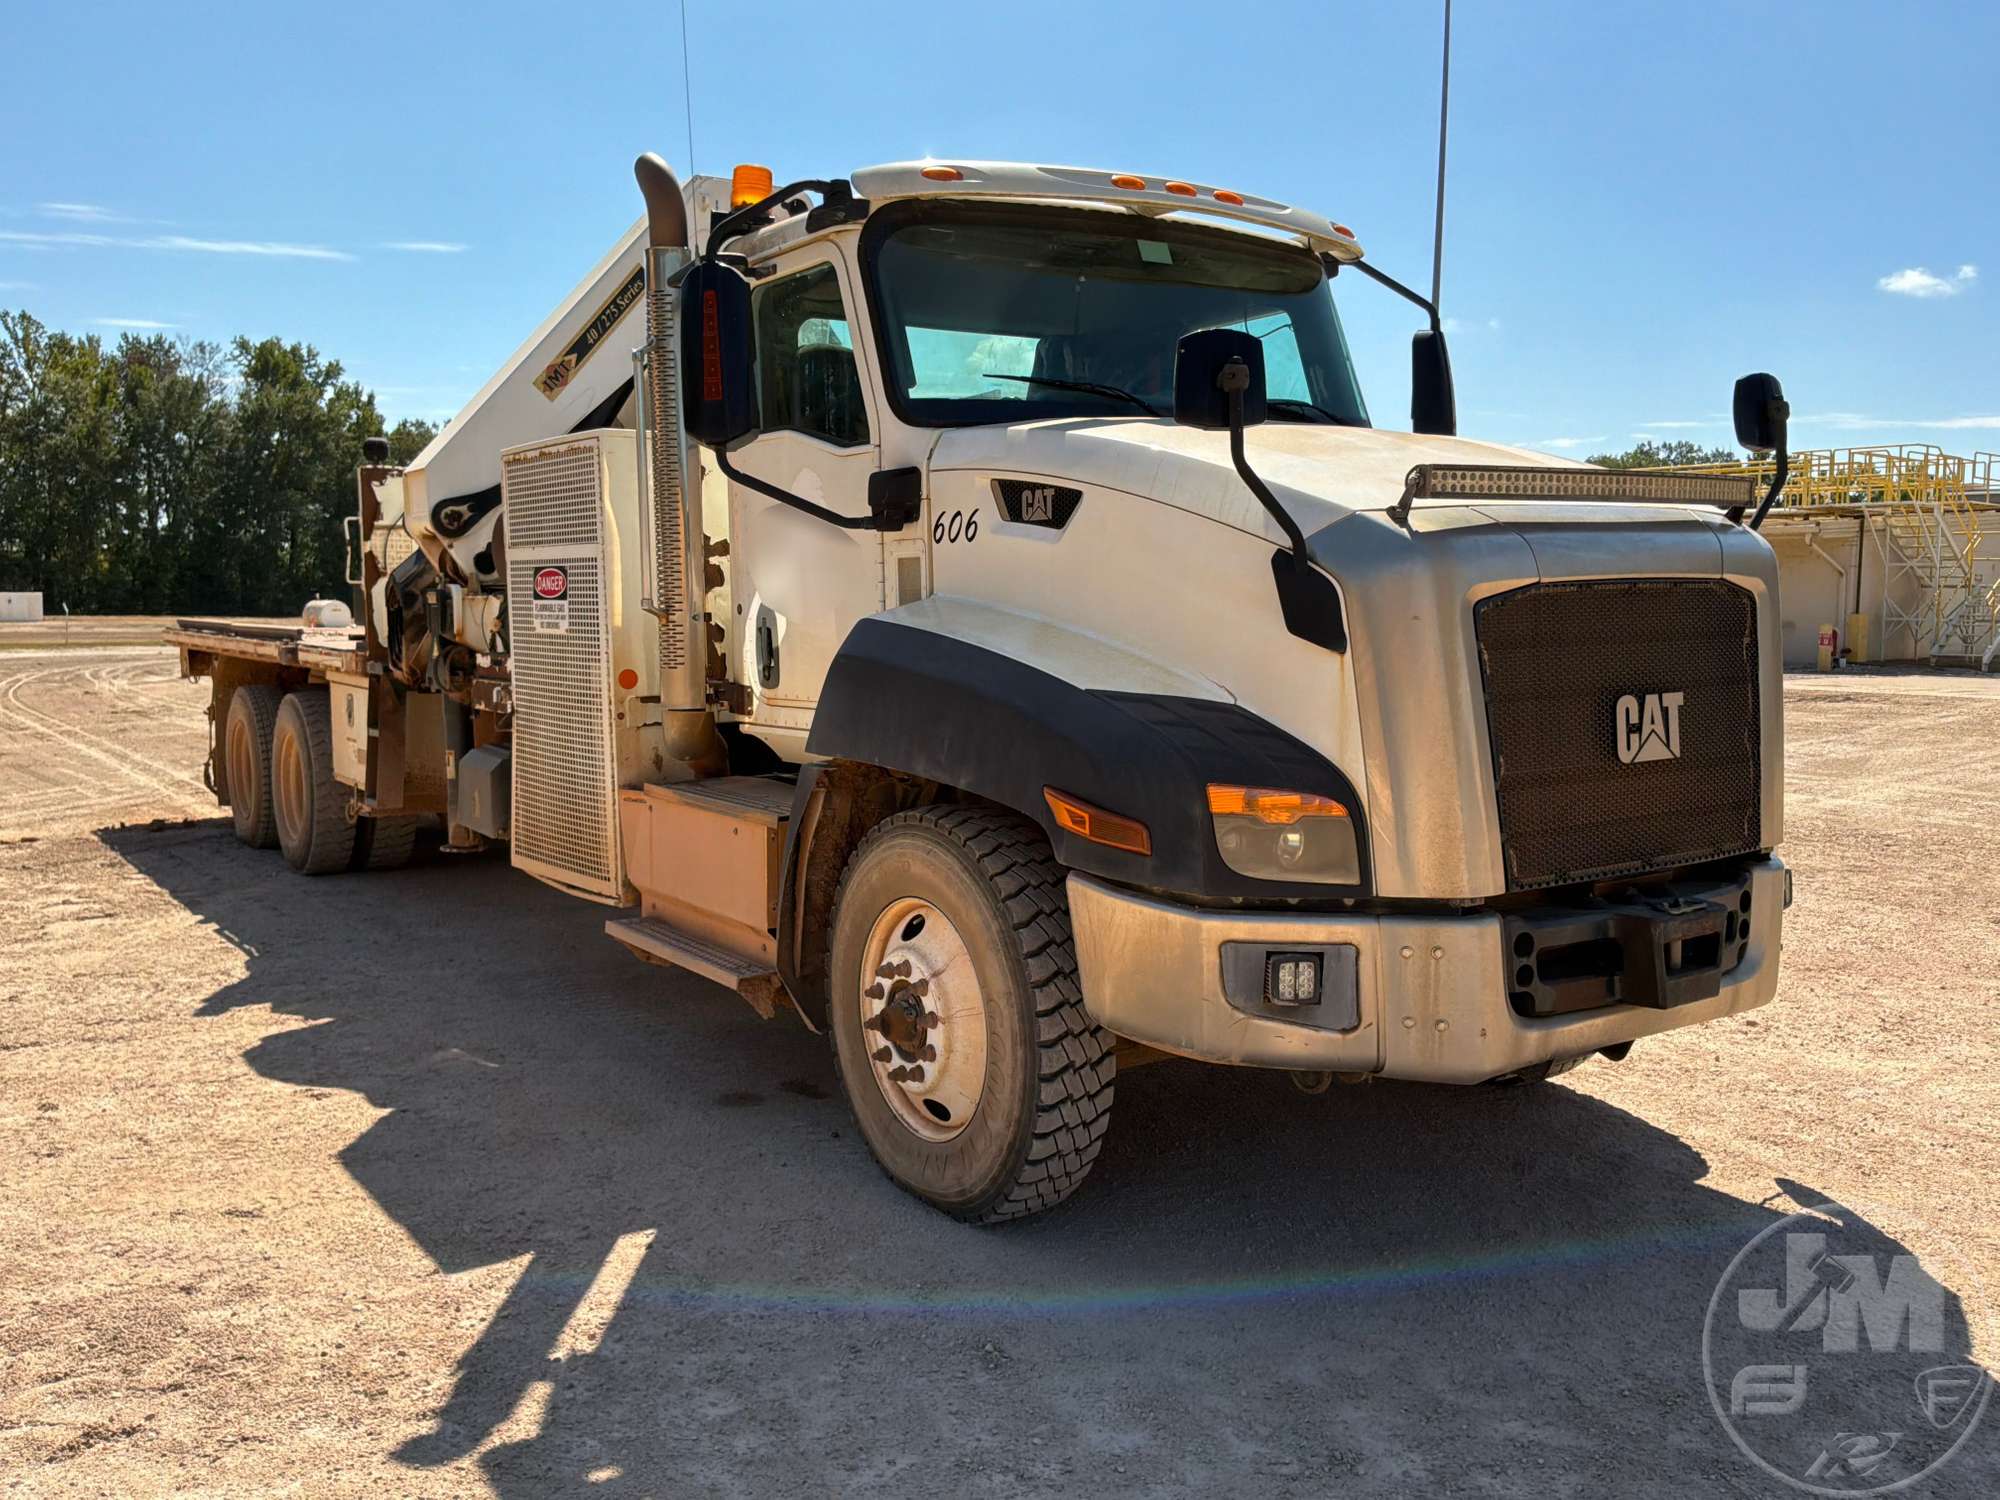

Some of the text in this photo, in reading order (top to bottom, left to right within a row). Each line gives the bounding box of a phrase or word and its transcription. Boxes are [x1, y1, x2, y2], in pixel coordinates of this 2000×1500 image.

[616, 280, 643, 309] Series
[1021, 487, 1056, 521] CAT
[933, 508, 979, 544] 606
[537, 576, 563, 591] DANGER
[1616, 691, 1684, 764] CAT
